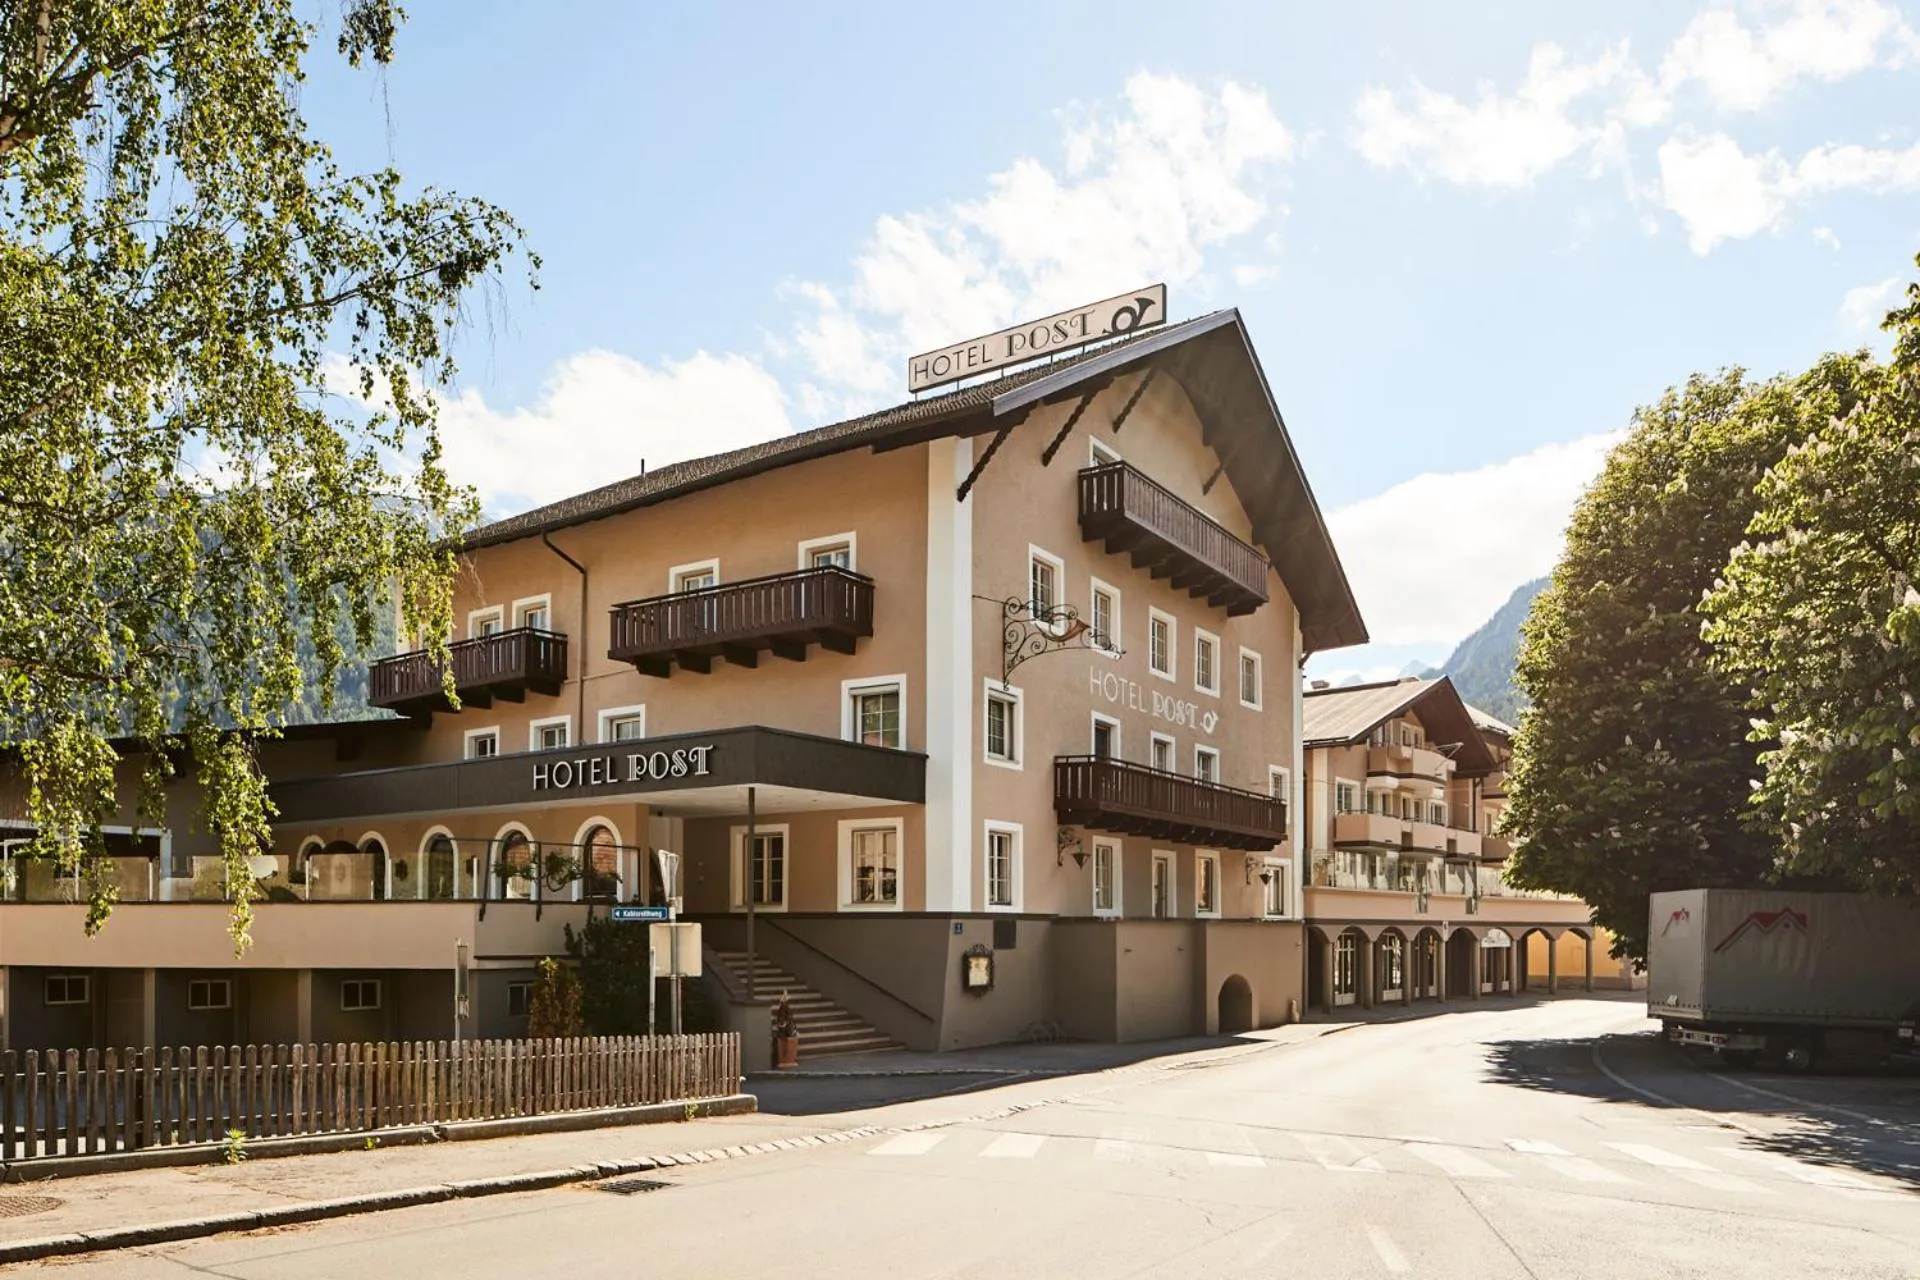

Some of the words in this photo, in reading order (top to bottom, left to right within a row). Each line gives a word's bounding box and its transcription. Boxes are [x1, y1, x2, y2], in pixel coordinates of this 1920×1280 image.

[914, 343, 993, 383] HOTEL
[1005, 310, 1095, 357] POST
[1089, 665, 1147, 713] HOTEL
[1151, 690, 1199, 729] POST
[533, 756, 618, 791] HOTEL
[626, 744, 714, 782] POST
